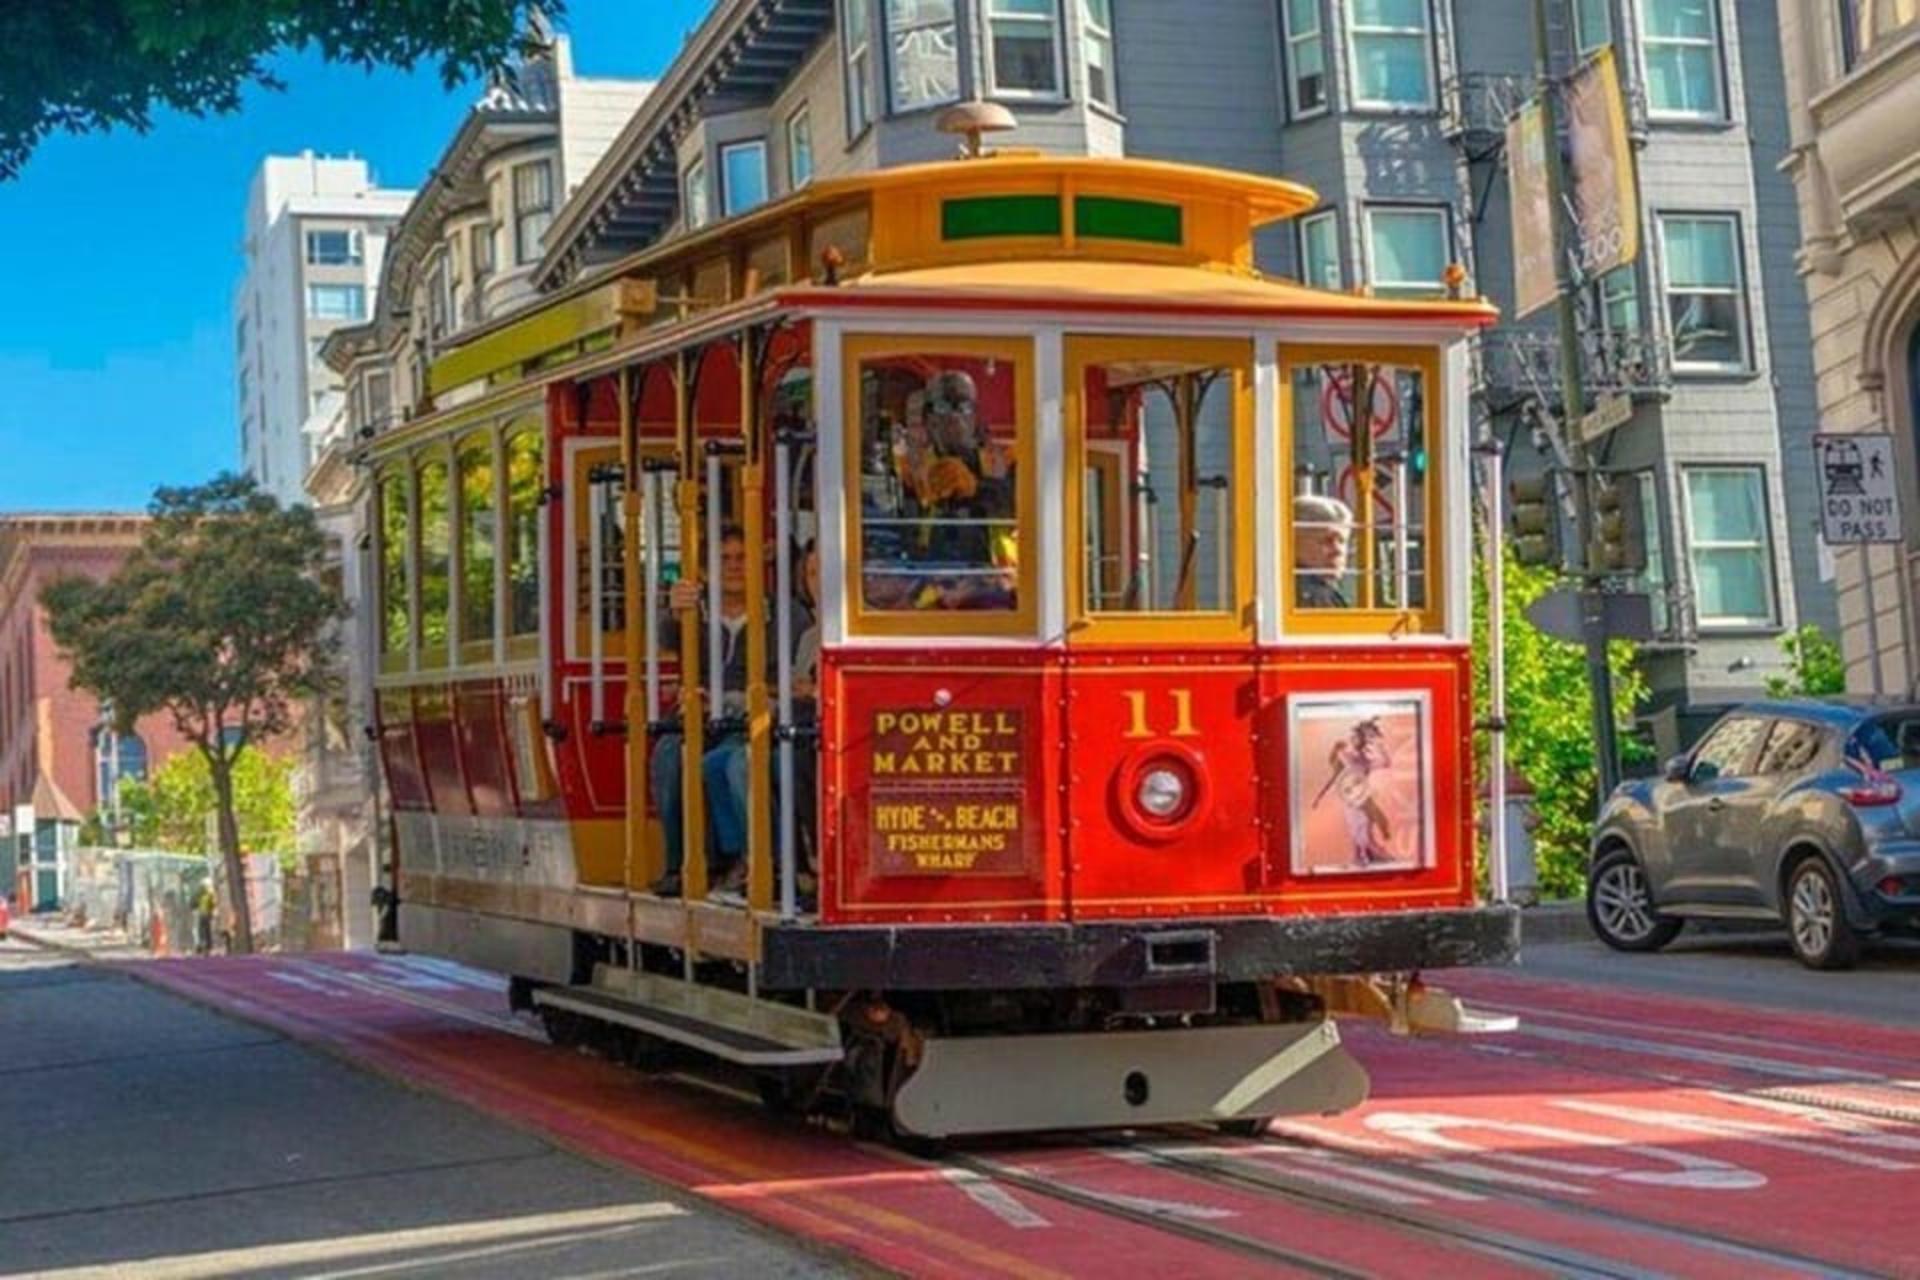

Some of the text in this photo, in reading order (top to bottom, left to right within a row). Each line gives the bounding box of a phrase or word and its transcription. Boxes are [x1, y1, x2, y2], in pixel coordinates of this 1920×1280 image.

[1580, 226, 1624, 269] ZOO
[1827, 497, 1892, 518] DO NOT
[1840, 521, 1887, 537] PASS
[876, 712, 1016, 735] POWELL
[1120, 689, 1202, 738] 11
[912, 734, 981, 750] AND
[873, 751, 1018, 774] MARKET
[875, 805, 926, 830] HYDE
[955, 805, 1018, 830] BEACH
[888, 832, 1005, 851] FISHERMANS
[915, 851, 979, 869] WHARF
